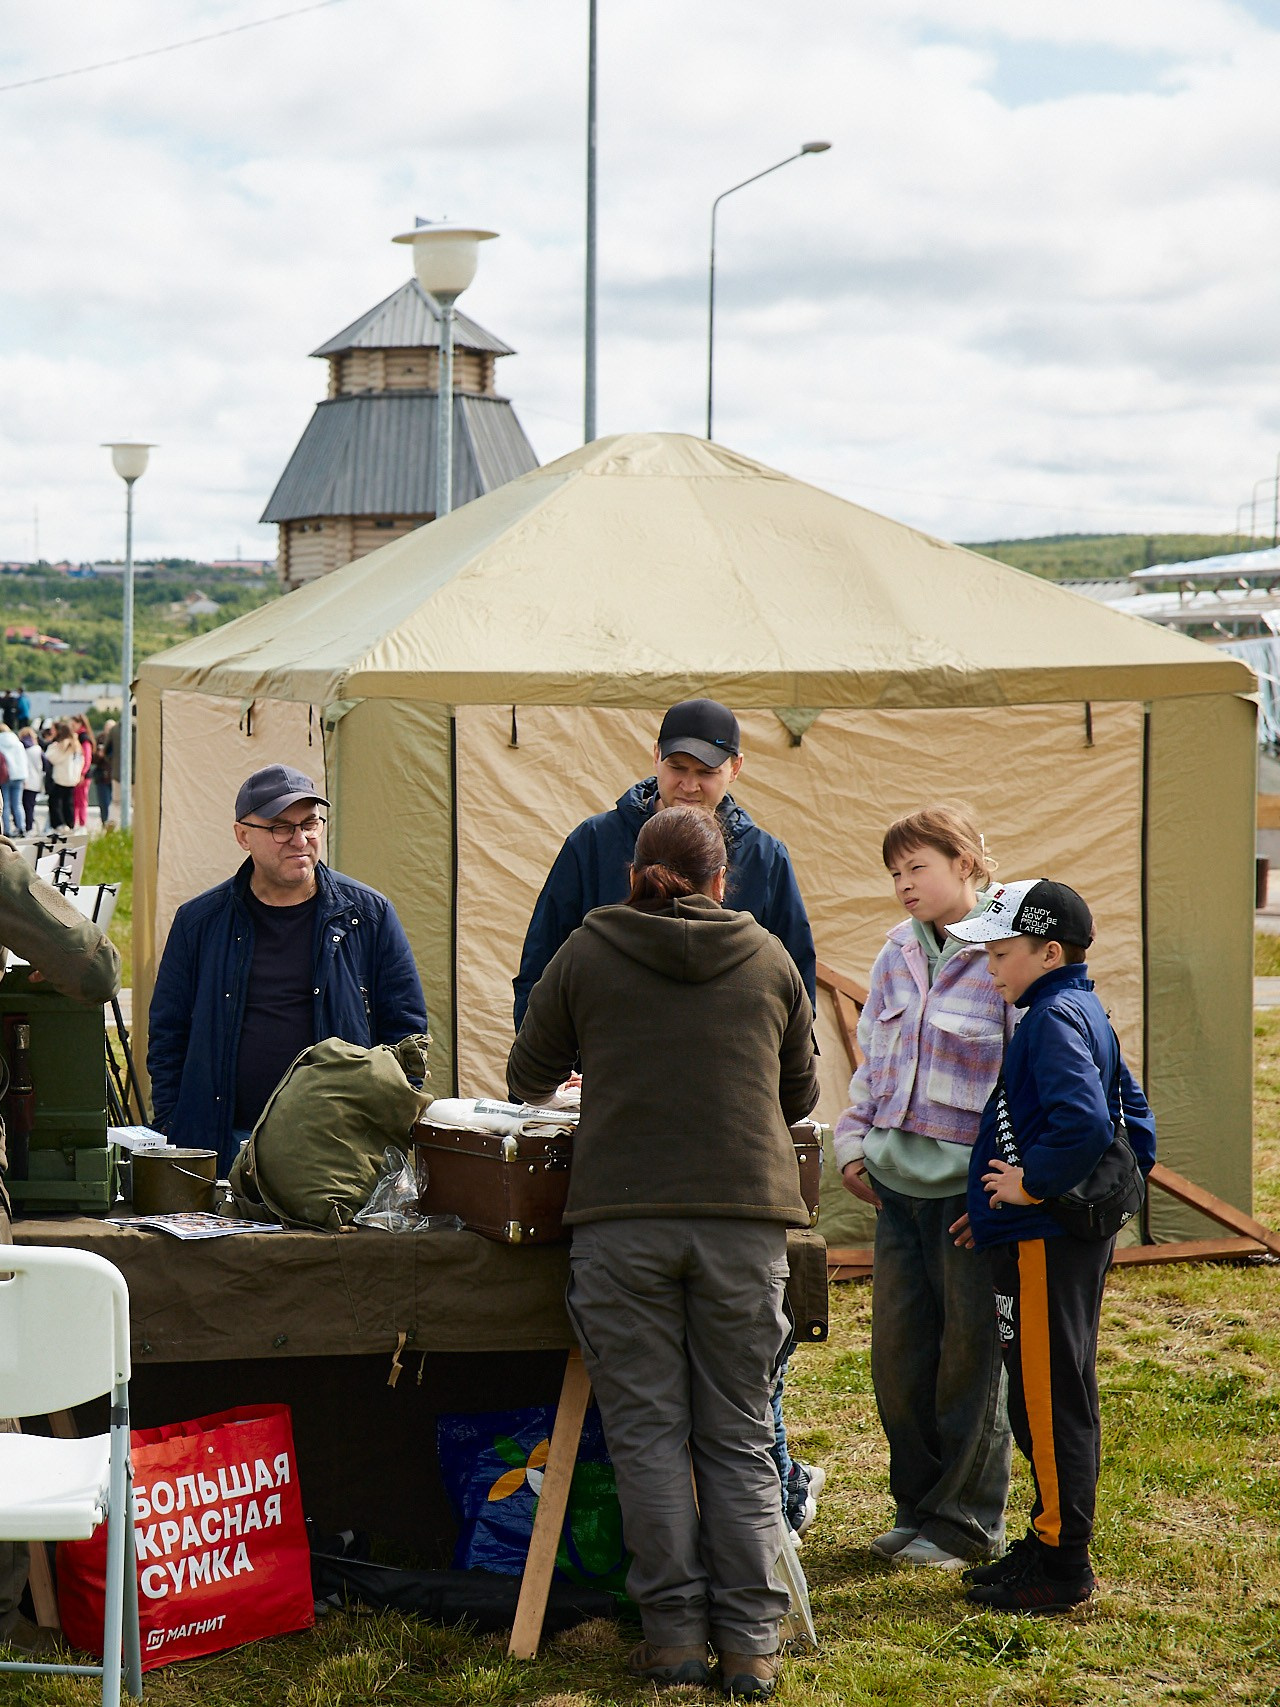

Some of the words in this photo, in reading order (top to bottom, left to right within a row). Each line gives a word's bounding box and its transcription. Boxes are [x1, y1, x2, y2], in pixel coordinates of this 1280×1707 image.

[1021, 912, 1043, 921] NOW
[1046, 916, 1058, 926] BE
[1023, 906, 1051, 917] STUDY
[1019, 924, 1046, 936] LATER
[1020, 918, 1049, 930] PROUD
[133, 1452, 291, 1521] БОЛЬШАЯ
[134, 1493, 283, 1561] КРАСНАЯ
[140, 1541, 255, 1600] СУМКА
[166, 1614, 227, 1643] МАГНИТ
